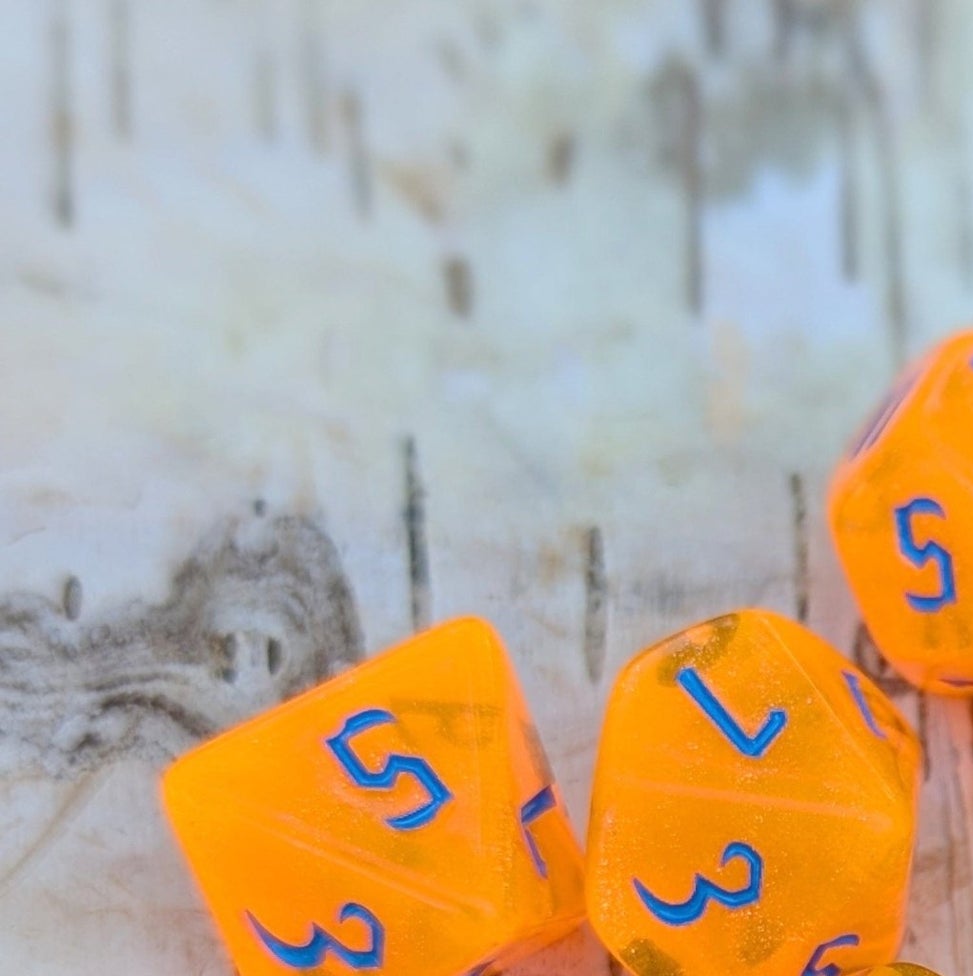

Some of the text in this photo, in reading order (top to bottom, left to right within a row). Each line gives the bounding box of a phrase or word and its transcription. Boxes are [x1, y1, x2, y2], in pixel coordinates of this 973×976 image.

[894, 497, 956, 612] 5
[324, 708, 454, 831] 5
[633, 841, 765, 926] 3
[245, 902, 385, 970] 3
